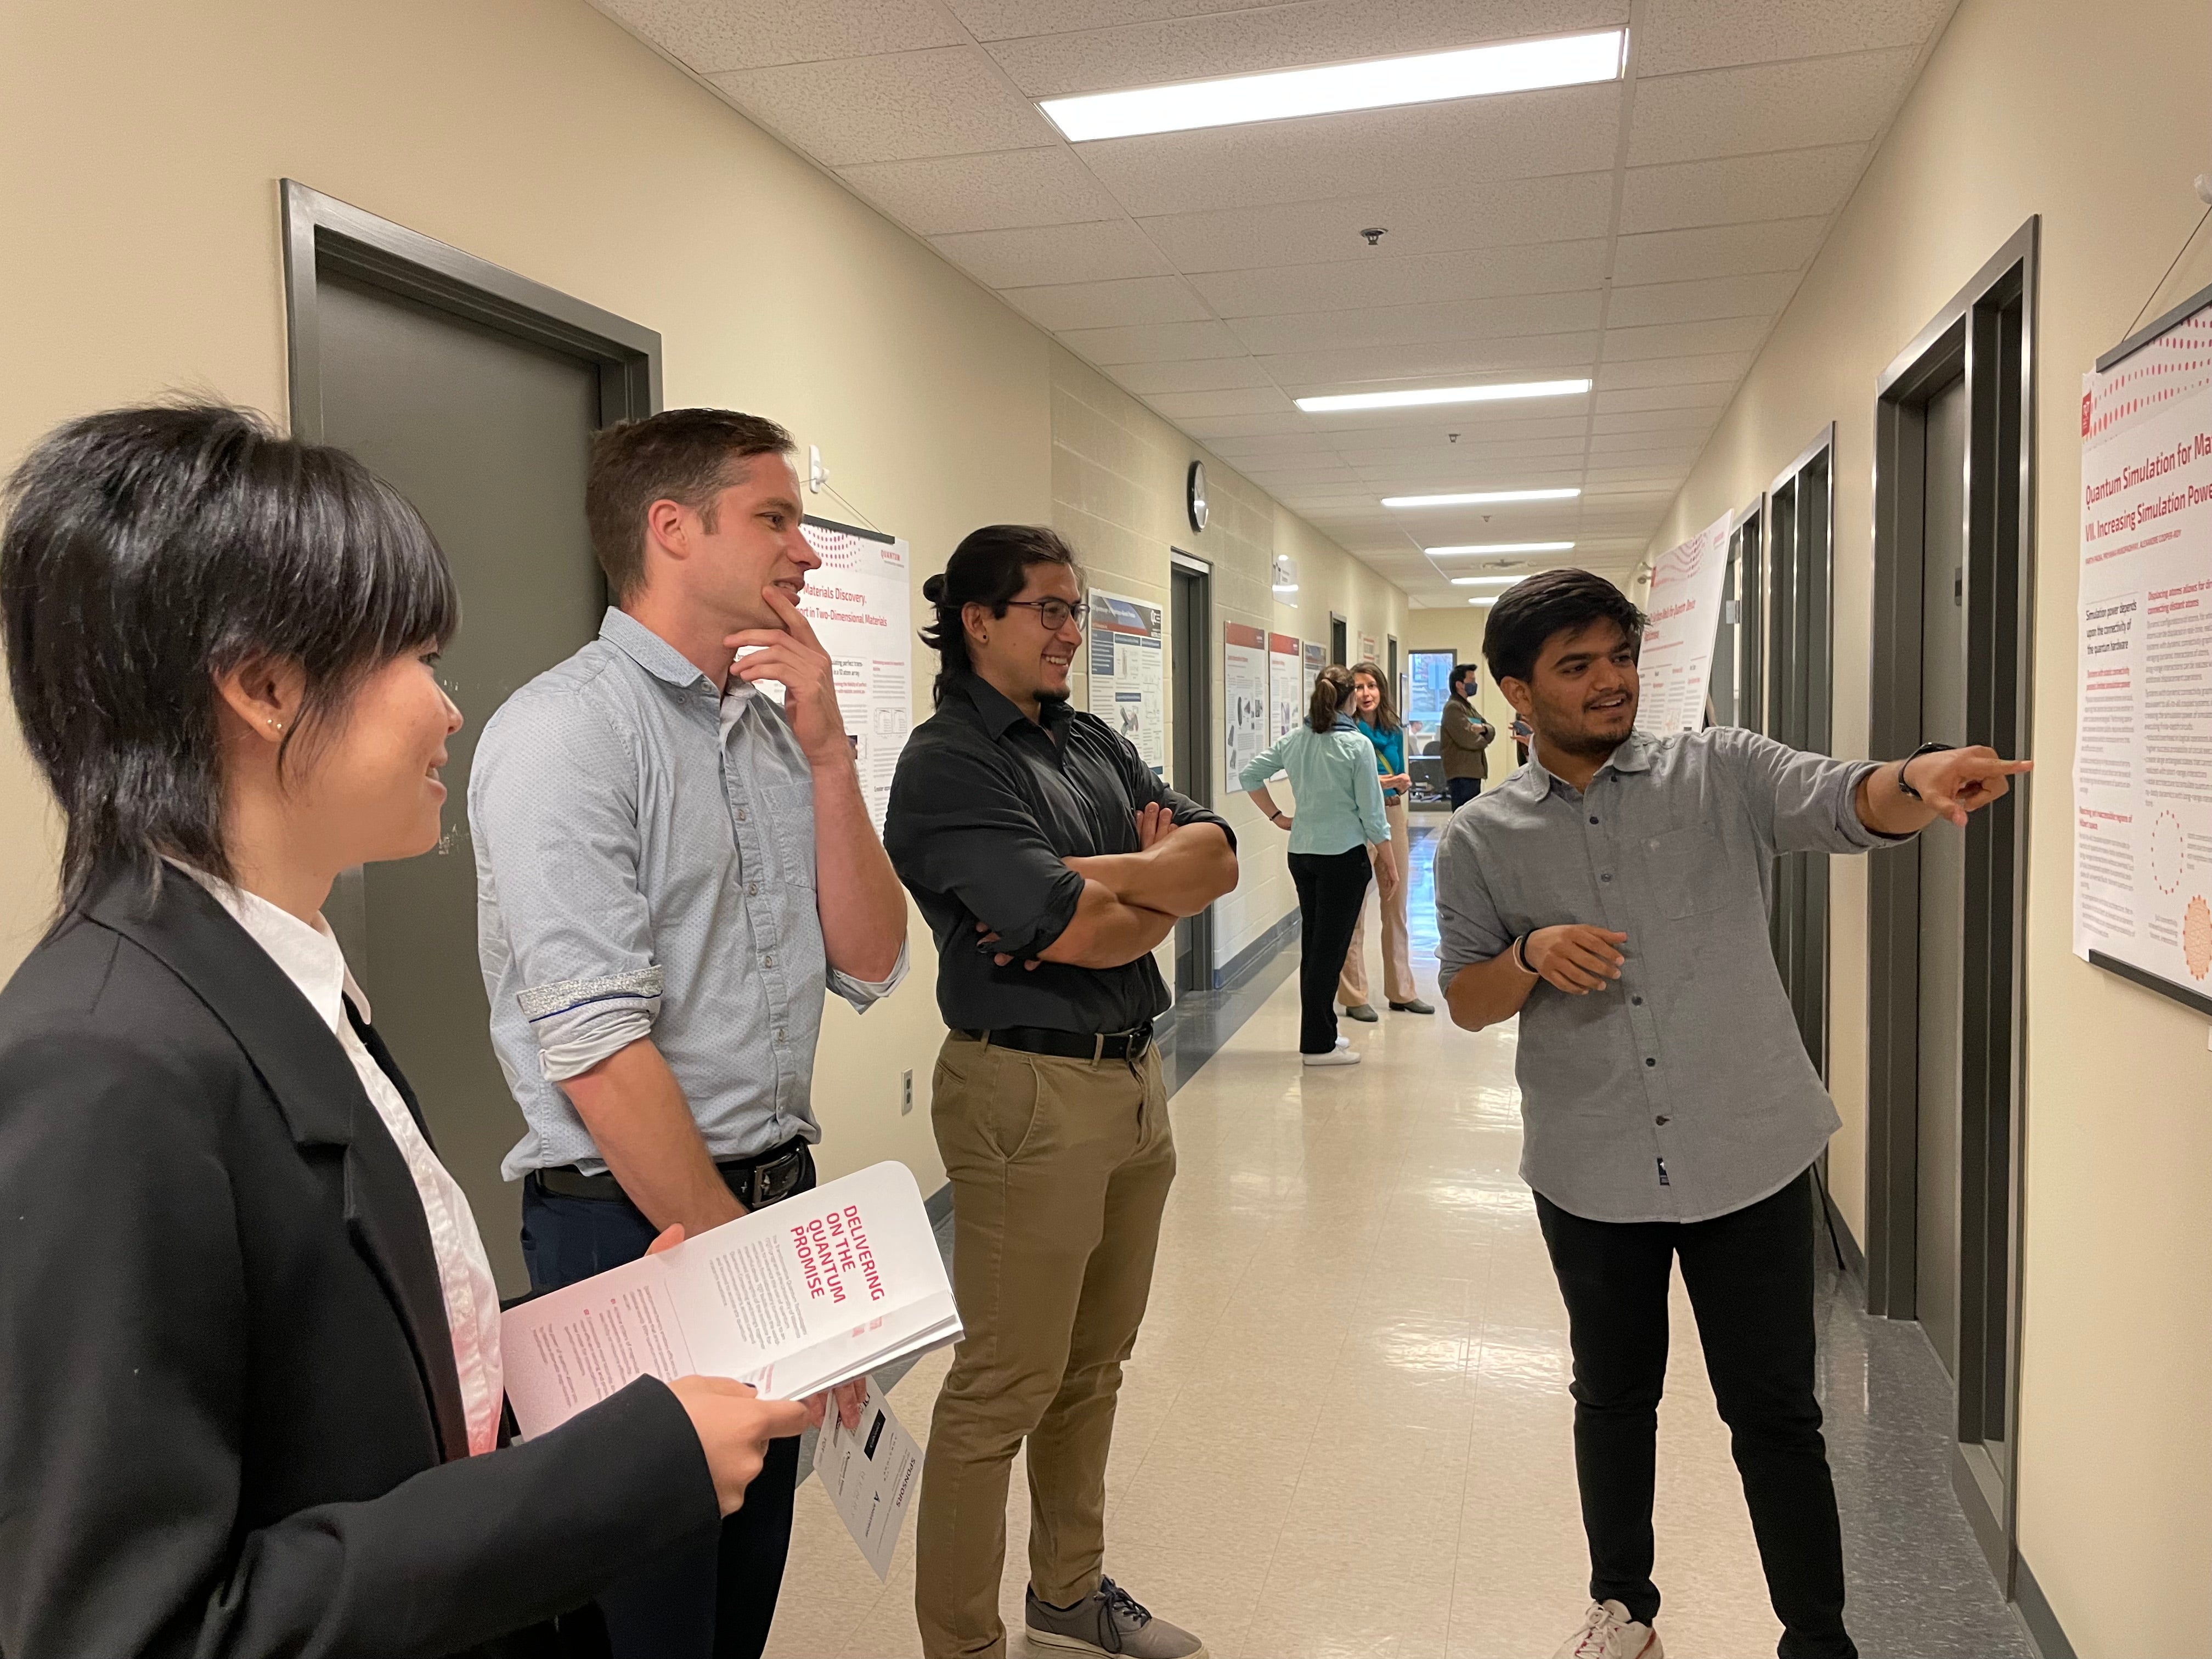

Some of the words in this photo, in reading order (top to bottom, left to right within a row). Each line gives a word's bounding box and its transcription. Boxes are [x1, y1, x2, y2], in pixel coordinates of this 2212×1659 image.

[2086, 477, 2121, 510] Quantum
[2123, 452, 2175, 489] Simulation
[2177, 442, 2192, 467] for
[2194, 433, 2212, 459] Ma
[2097, 510, 2136, 538] Increasing
[2137, 492, 2186, 524] Simulation
[881, 550, 900, 561] QUANTUM
[804, 583, 834, 599] Materials
[835, 588, 867, 606] Discovery.
[809, 607, 815, 618] in
[816, 607, 864, 624] Two-Dimensional
[865, 614, 887, 627] Materials
[791, 1226, 825, 1300] PROMISE
[806, 1220, 846, 1304] QUANTUM
[827, 1212, 844, 1236] ON
[836, 1238, 855, 1272] THE
[844, 1205, 884, 1300] DELIVERING
[895, 1457, 916, 1508] SPONSORS
